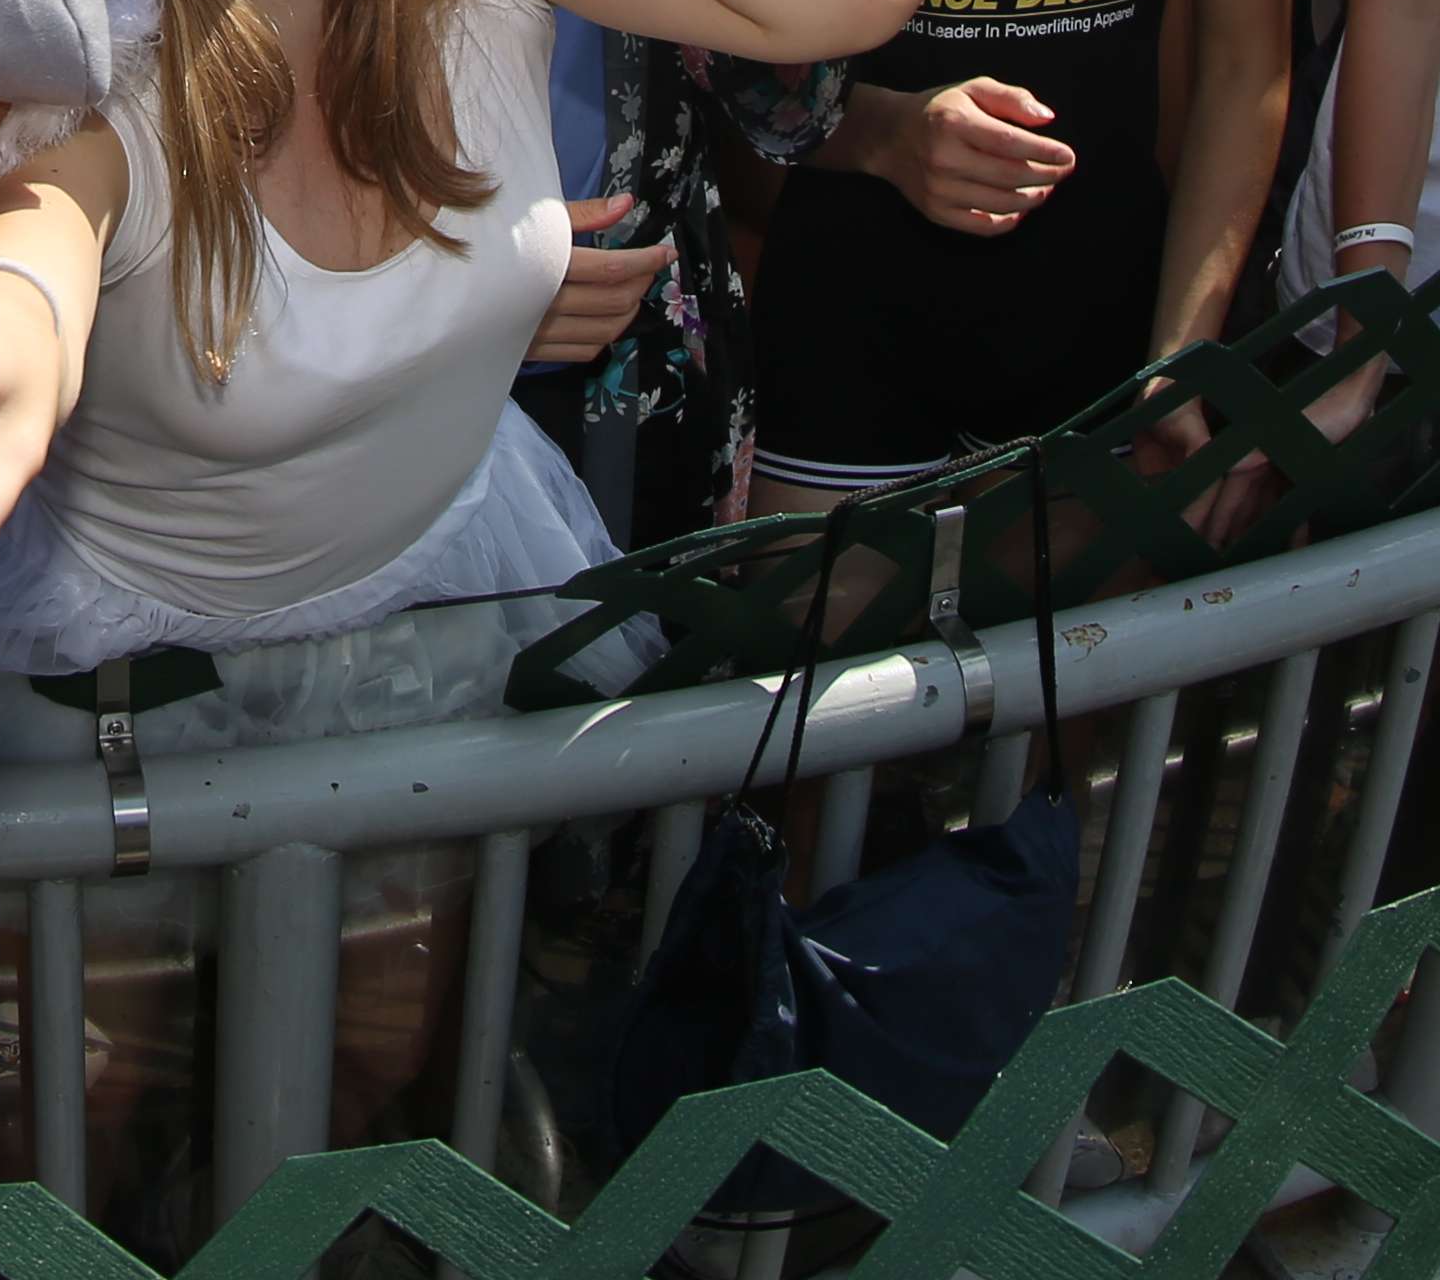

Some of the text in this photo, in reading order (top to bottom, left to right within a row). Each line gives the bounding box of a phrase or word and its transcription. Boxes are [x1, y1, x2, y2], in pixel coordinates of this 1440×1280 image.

[927, 20, 982, 39] Leader
[985, 23, 1000, 38] In
[1004, 15, 1091, 39] Powerlifting
[1093, 3, 1136, 29] Apparel
